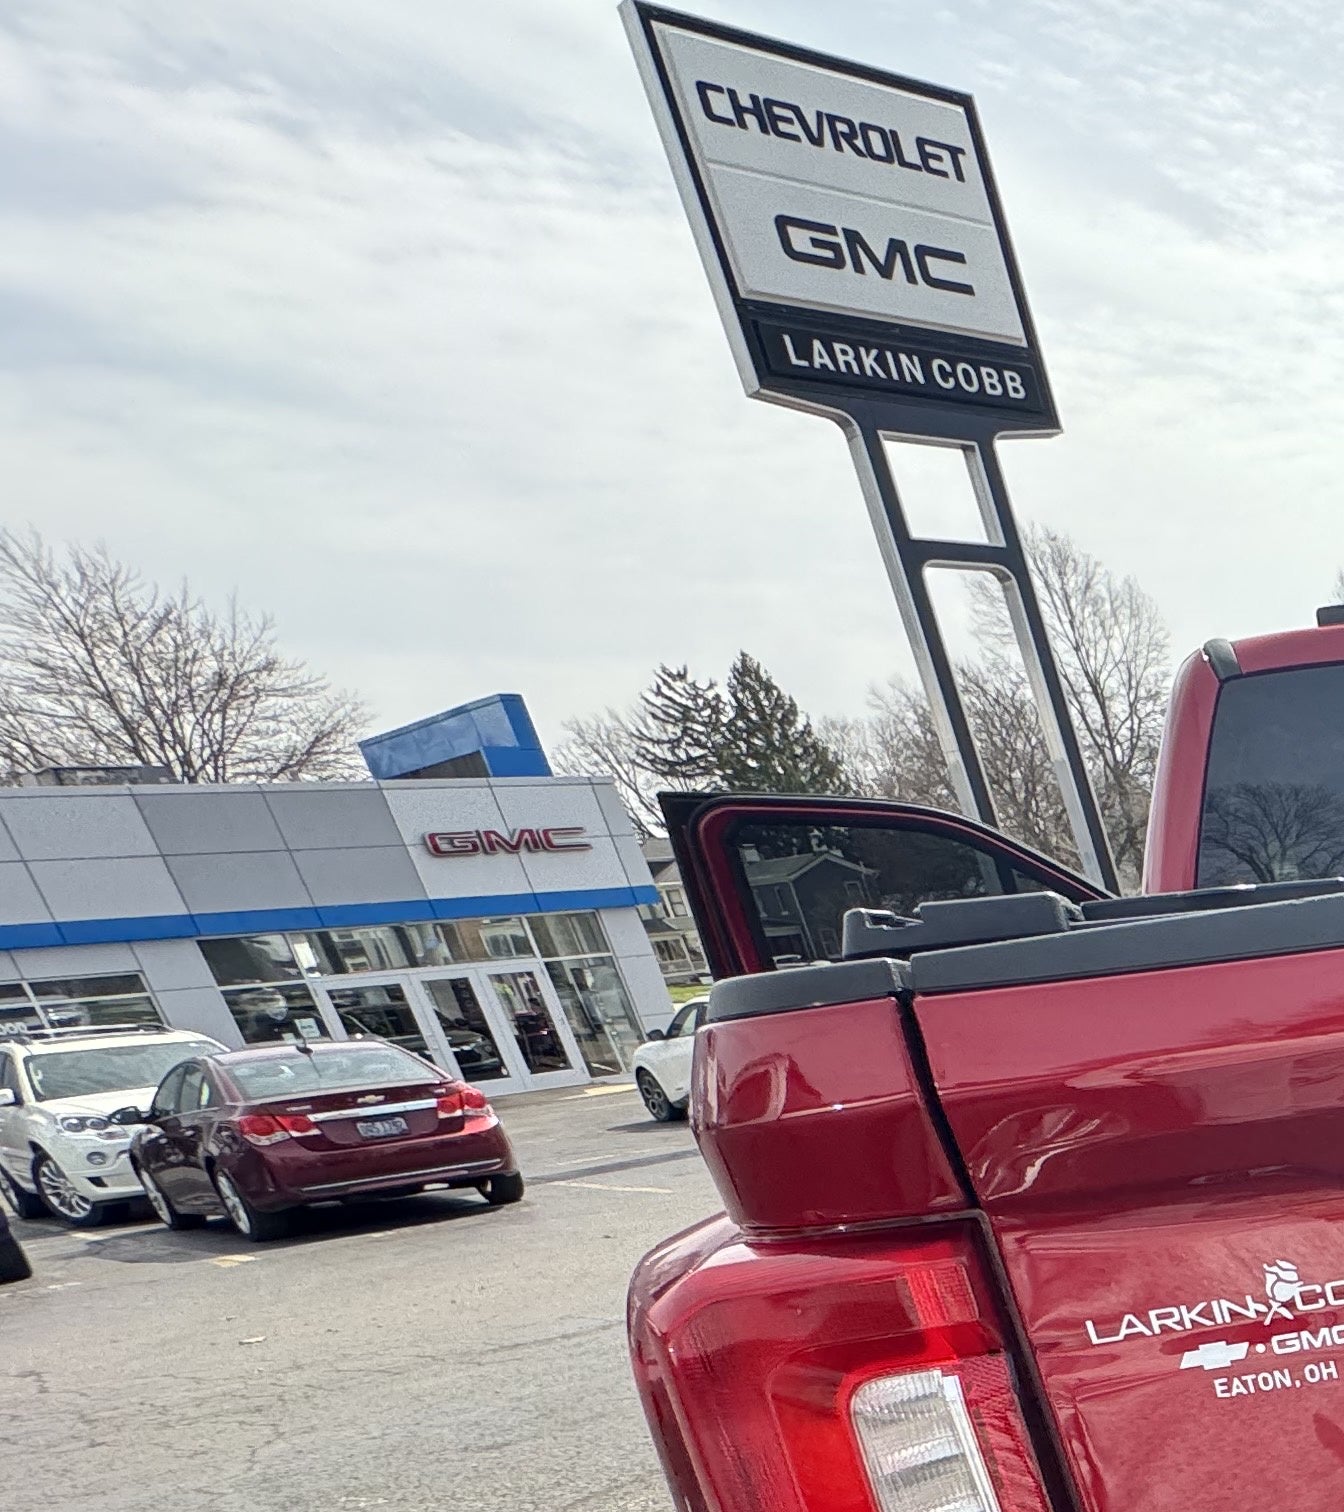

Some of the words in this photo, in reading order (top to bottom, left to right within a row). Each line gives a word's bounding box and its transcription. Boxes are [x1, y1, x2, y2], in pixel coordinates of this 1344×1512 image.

[695, 79, 966, 183] CHEVROLET
[774, 213, 976, 297] GMC
[782, 333, 926, 386] LARKIN
[931, 358, 1027, 400] COBB
[423, 826, 594, 858] GMC
[1085, 1295, 1263, 1345] LARKIN
[1213, 1368, 1301, 1399] EATON,
[1304, 1360, 1339, 1384] OH
